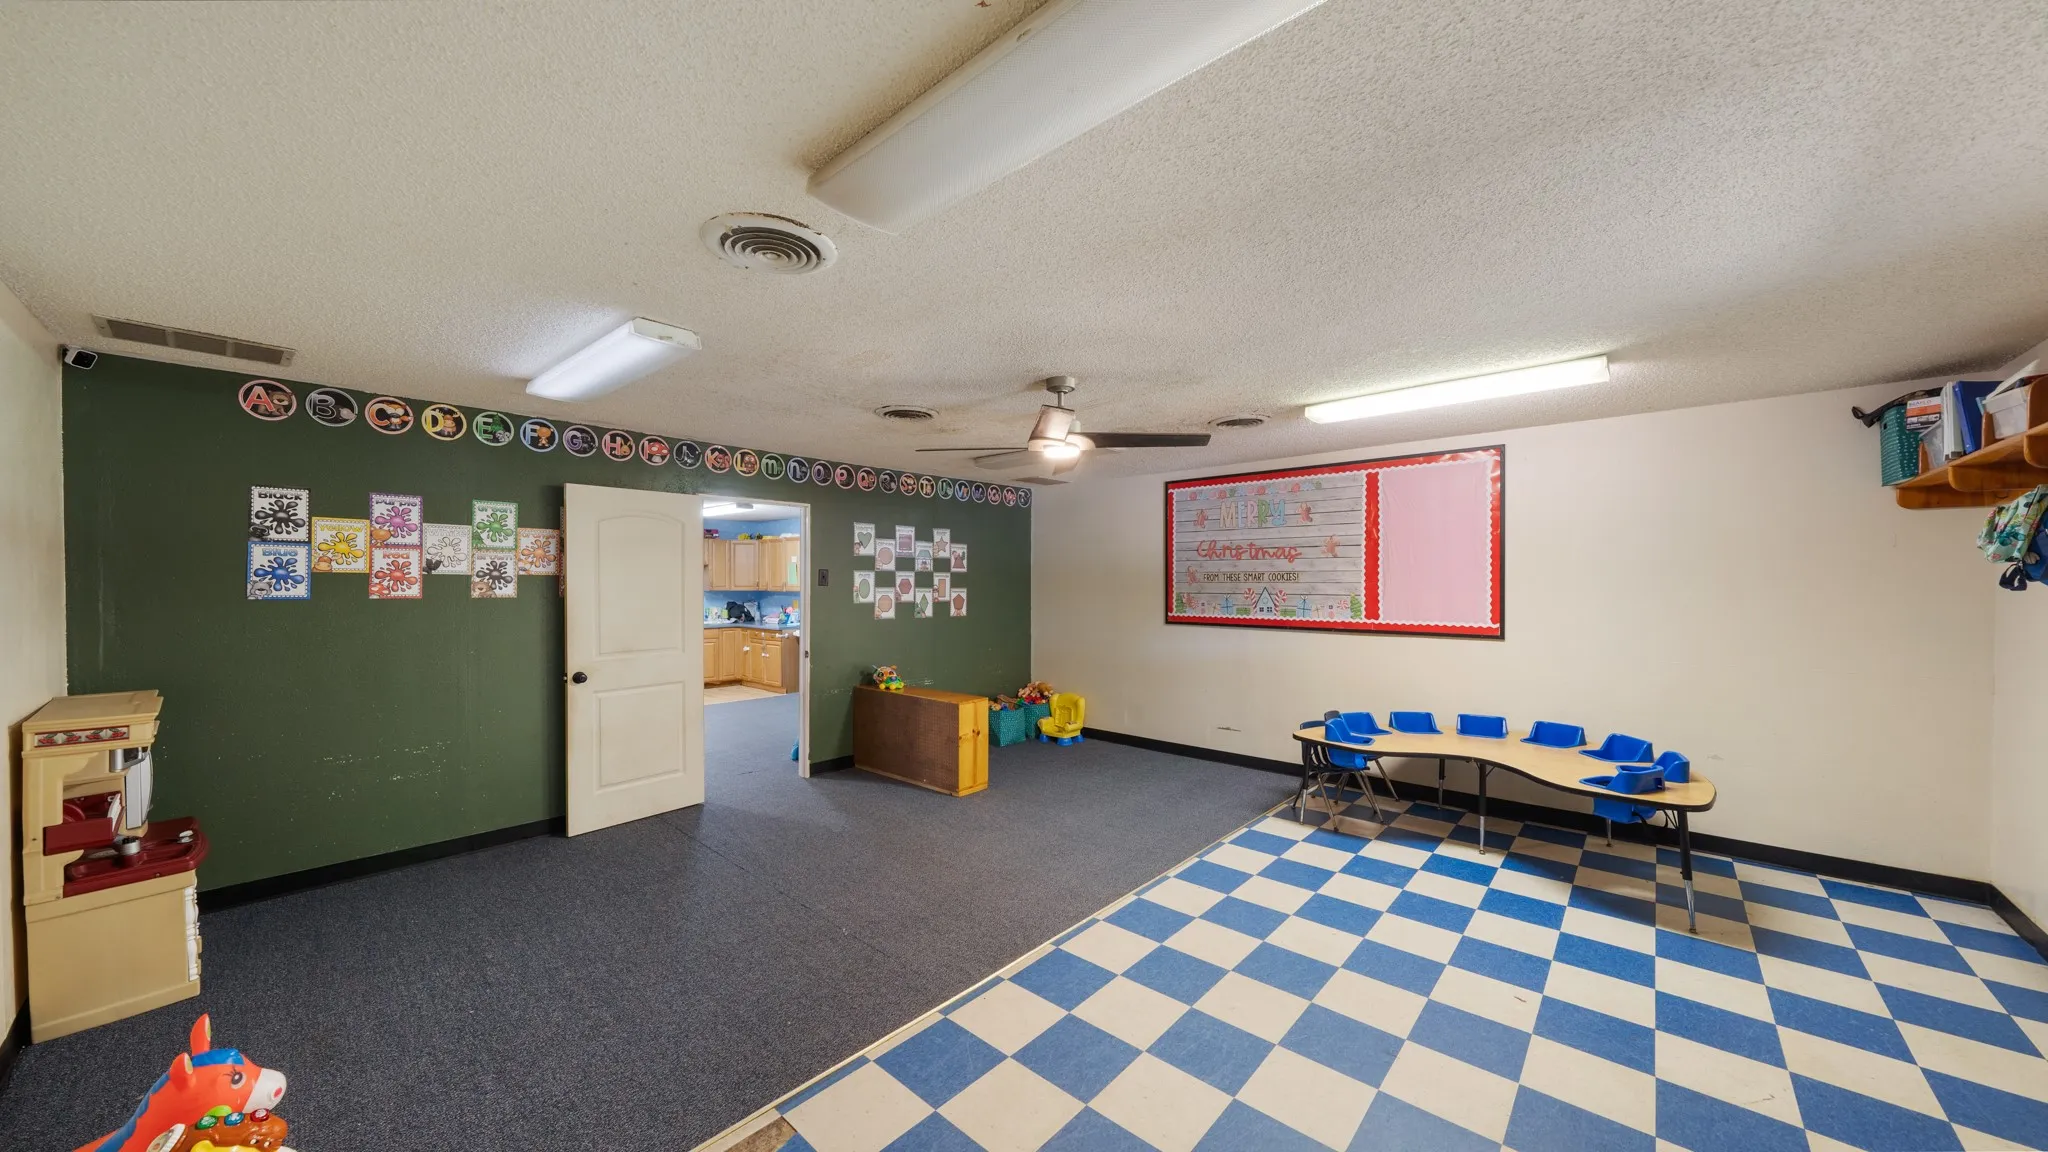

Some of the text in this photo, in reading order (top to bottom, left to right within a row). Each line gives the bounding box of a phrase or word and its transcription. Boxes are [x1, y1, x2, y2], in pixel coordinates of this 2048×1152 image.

[244, 386, 275, 412] A
[311, 394, 338, 420] B
[368, 402, 390, 427] C
[426, 410, 444, 432] D
[477, 417, 493, 439] E
[526, 424, 540, 444] F
[565, 431, 583, 450] G
[604, 436, 621, 456] H
[708, 451, 721, 468] K
[736, 453, 746, 471] L
[258, 490, 303, 500] Black
[1220, 499, 1287, 528] MERRY
[262, 548, 298, 556] Blue
[383, 551, 410, 559] Red
[1197, 540, 1302, 563] Christmas
[1203, 572, 1299, 582] FROM THESE SMART COOKIES!
